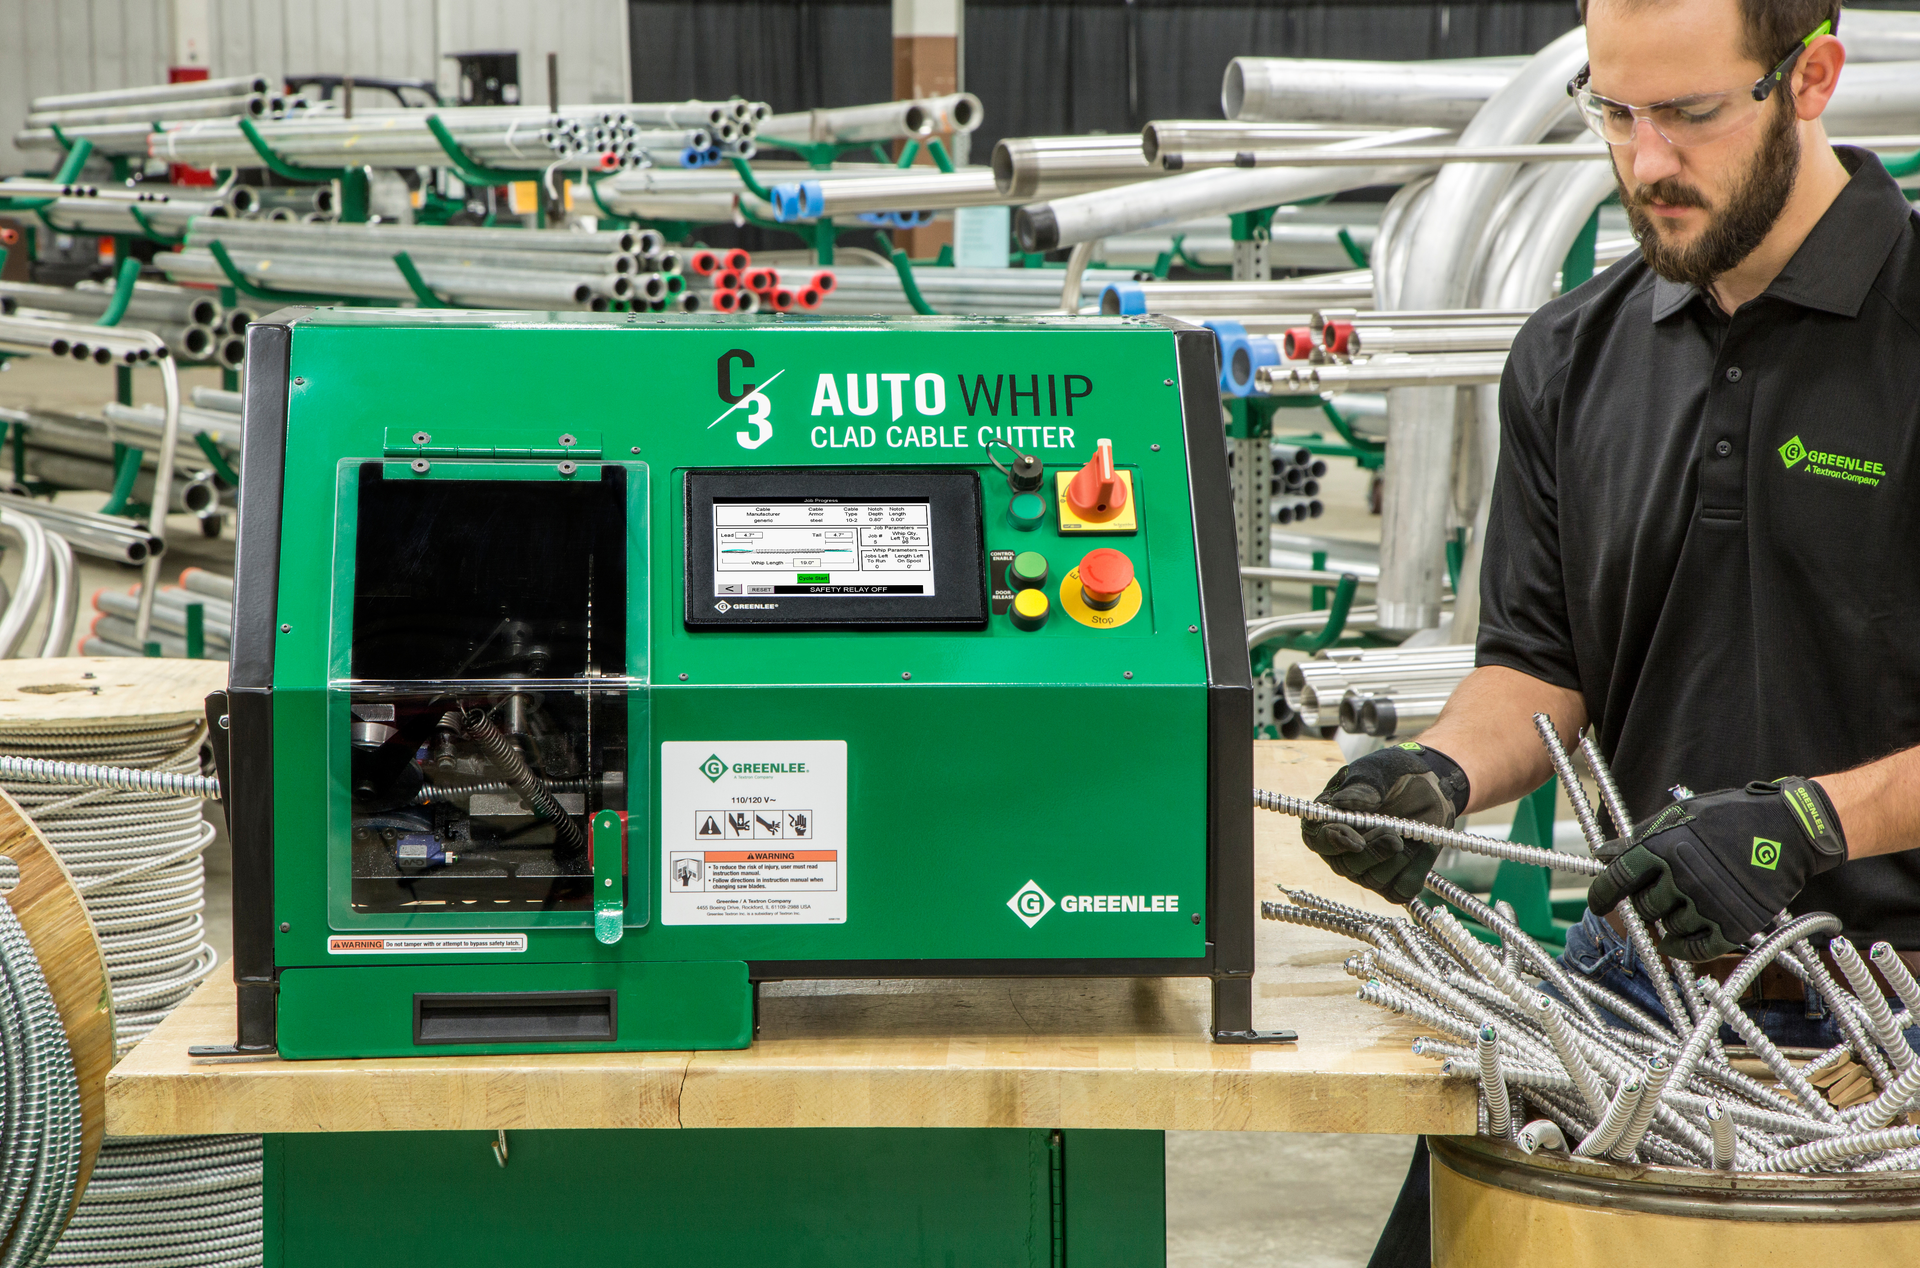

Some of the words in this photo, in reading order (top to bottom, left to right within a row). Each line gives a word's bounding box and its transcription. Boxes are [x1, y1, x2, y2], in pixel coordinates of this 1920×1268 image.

[811, 373, 945, 422] AUTO
[958, 374, 1093, 416] WHIP
[811, 426, 876, 448] CLAD
[886, 426, 968, 448] CABLE
[978, 426, 1075, 448] CUTTER
[1804, 464, 1811, 472] A
[1812, 465, 1841, 478] Textron
[1842, 471, 1879, 486] Company
[1092, 616, 1113, 624] Stop
[1061, 895, 1179, 912] GREENLEE
